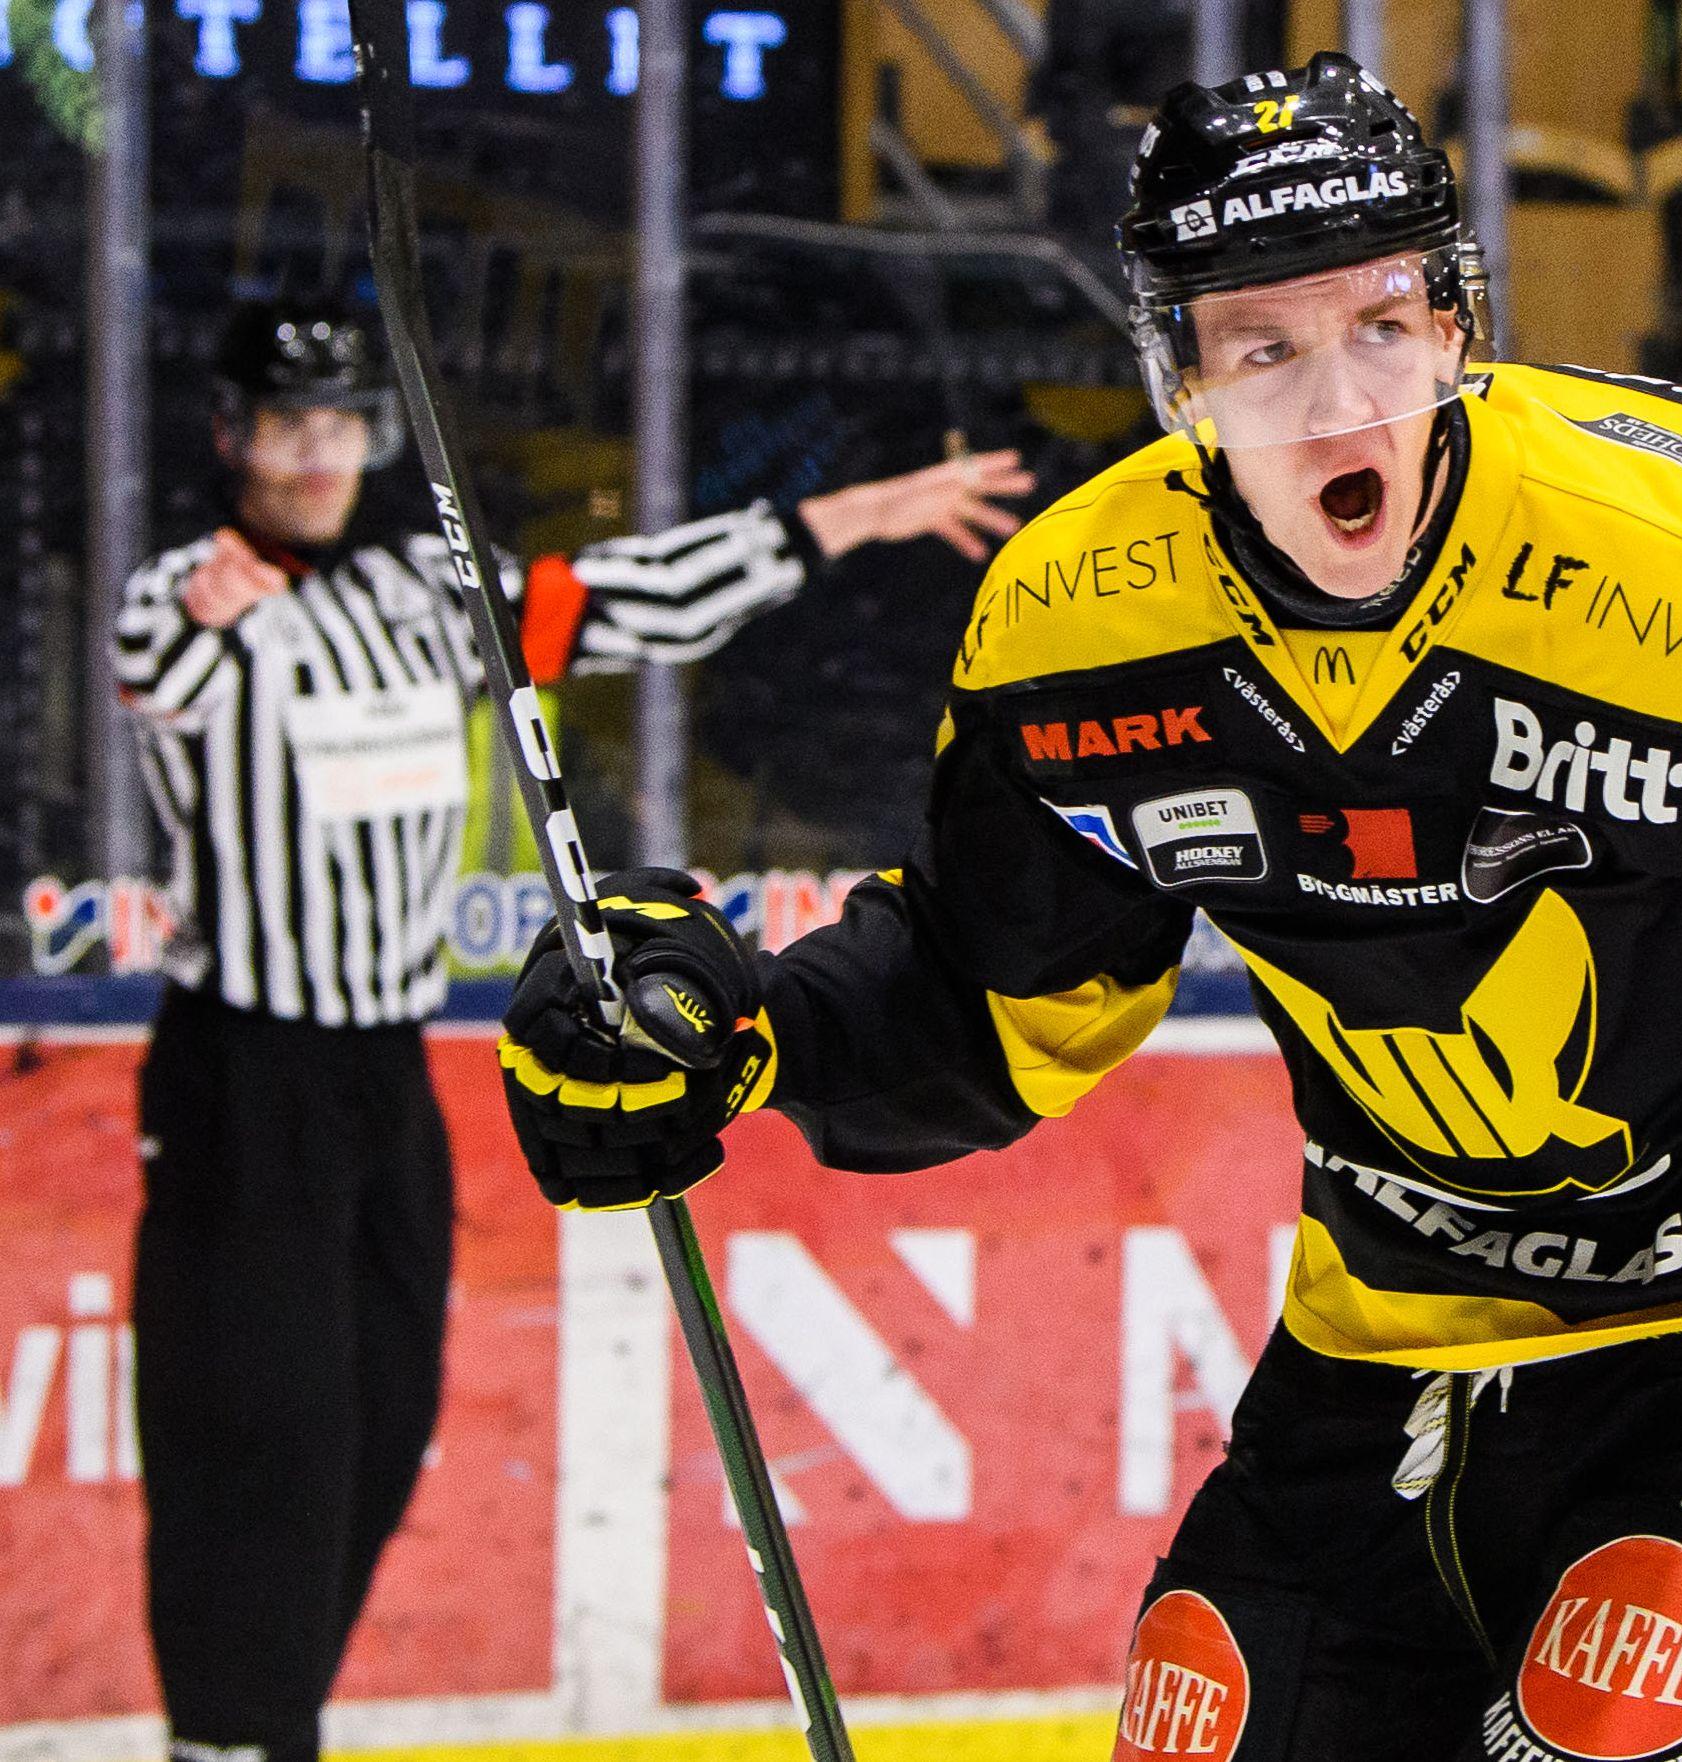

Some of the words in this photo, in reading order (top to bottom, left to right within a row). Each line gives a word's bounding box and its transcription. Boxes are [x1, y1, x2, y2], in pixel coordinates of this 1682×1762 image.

[1223, 170, 1409, 227] ALFAGLAS
[430, 483, 480, 590] CCM
[1005, 531, 1181, 629] INVEST
[1204, 533, 1276, 647] CCM
[1399, 541, 1477, 664] CCM
[1502, 541, 1590, 611] LF
[1019, 706, 1213, 762] MARK
[1158, 800, 1229, 824] UNIBET
[1175, 845, 1245, 863] HOCKEY
[1297, 873, 1460, 907] BYGGMÄSTER
